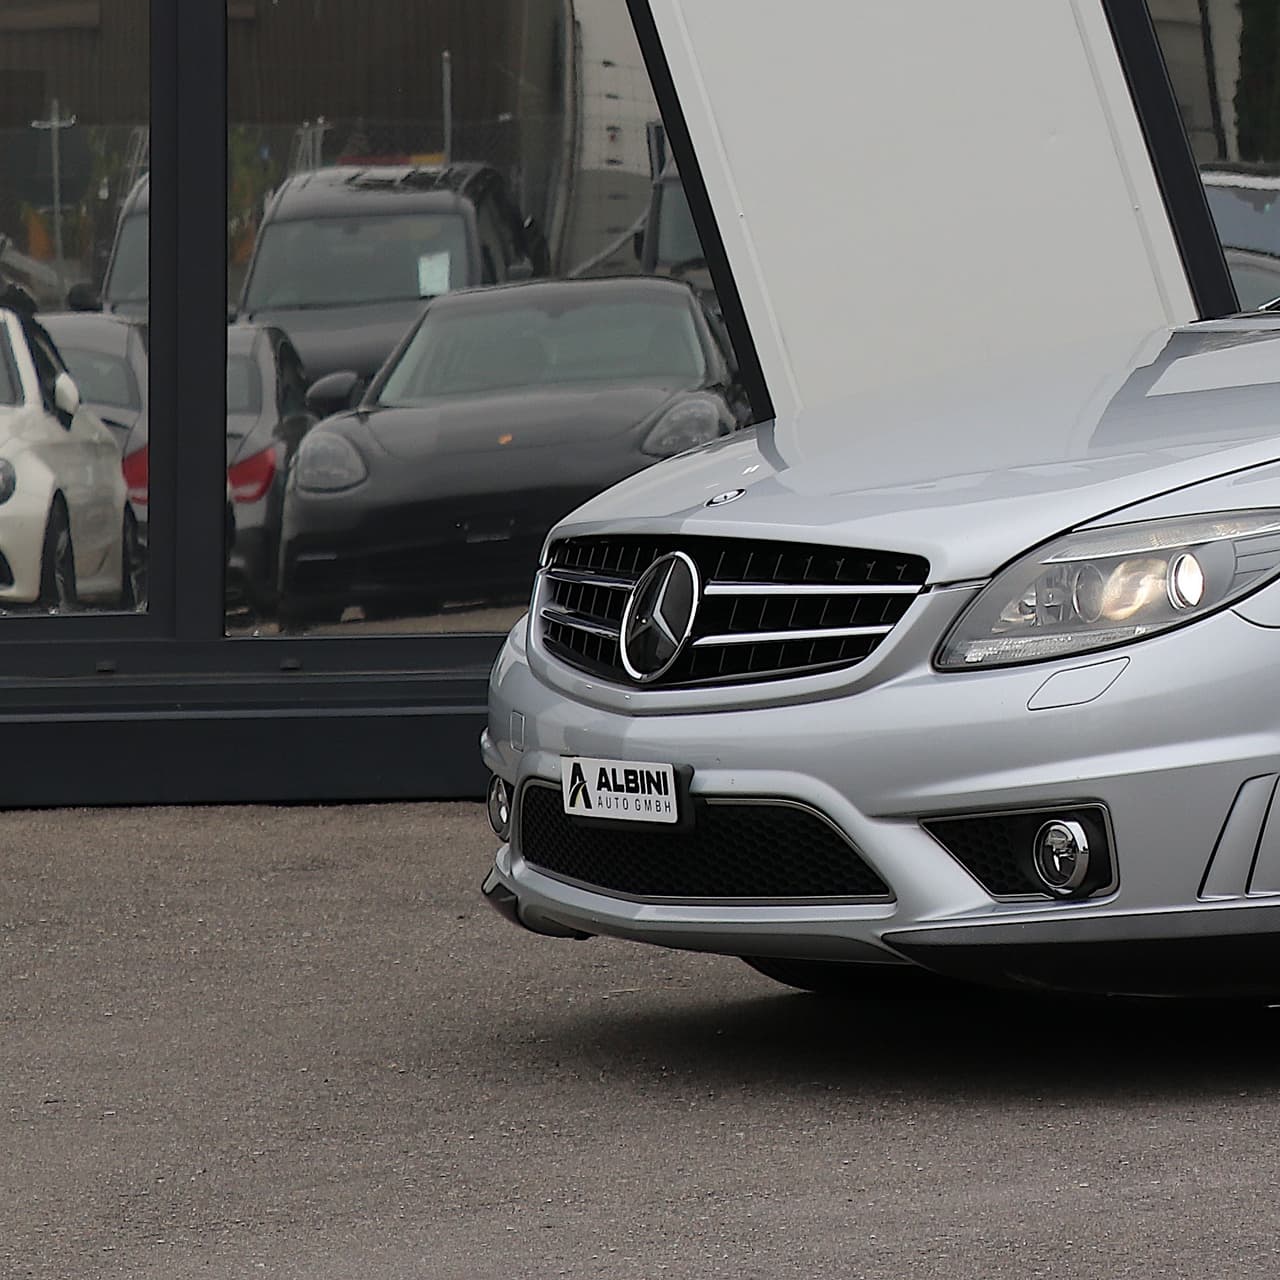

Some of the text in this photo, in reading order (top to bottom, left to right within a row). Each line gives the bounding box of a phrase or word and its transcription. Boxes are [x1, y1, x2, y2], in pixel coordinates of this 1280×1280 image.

[596, 767, 669, 796] ALBINI
[597, 796, 671, 813] AUTO GMBH
